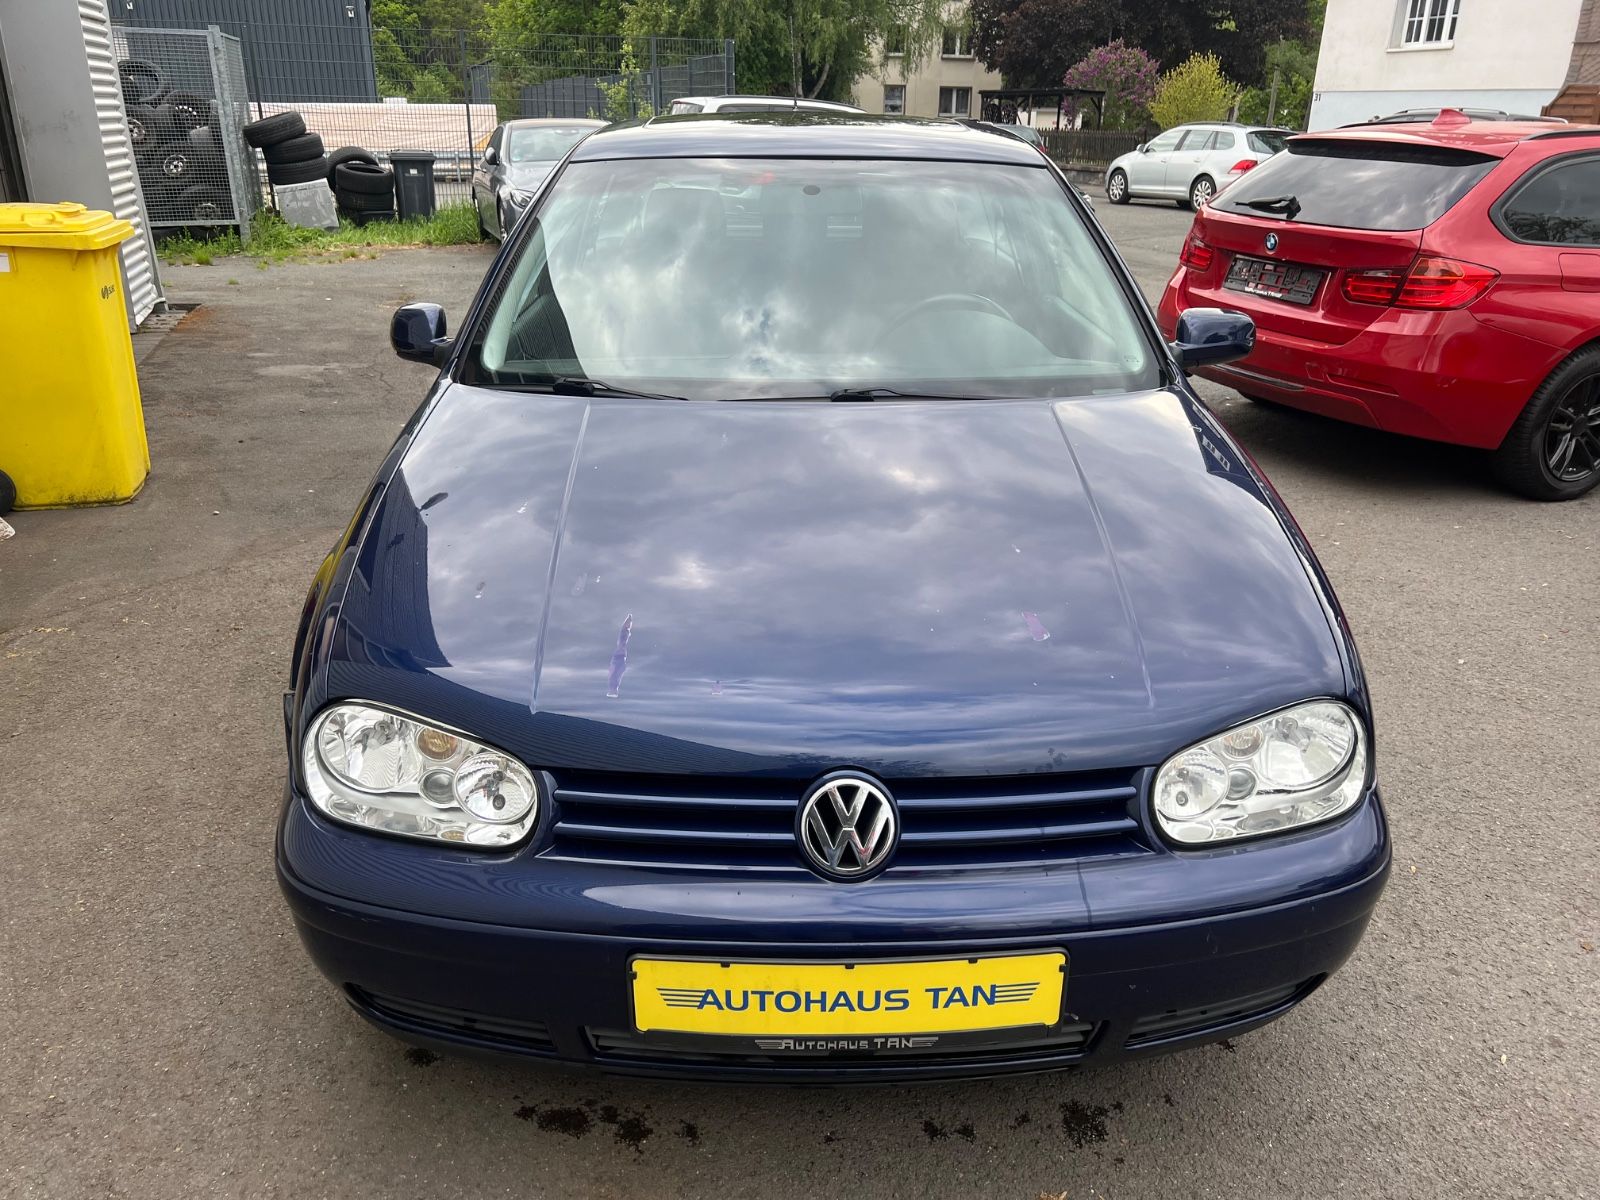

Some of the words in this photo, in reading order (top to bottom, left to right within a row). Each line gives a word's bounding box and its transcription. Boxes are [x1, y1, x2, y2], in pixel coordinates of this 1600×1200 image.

[1314, 93, 1322, 102] 31
[697, 988, 909, 1013] AUTOHAUS
[925, 984, 997, 1009] TAN
[779, 1038, 868, 1050] AUTOHAUS
[873, 1036, 912, 1049] TAN
